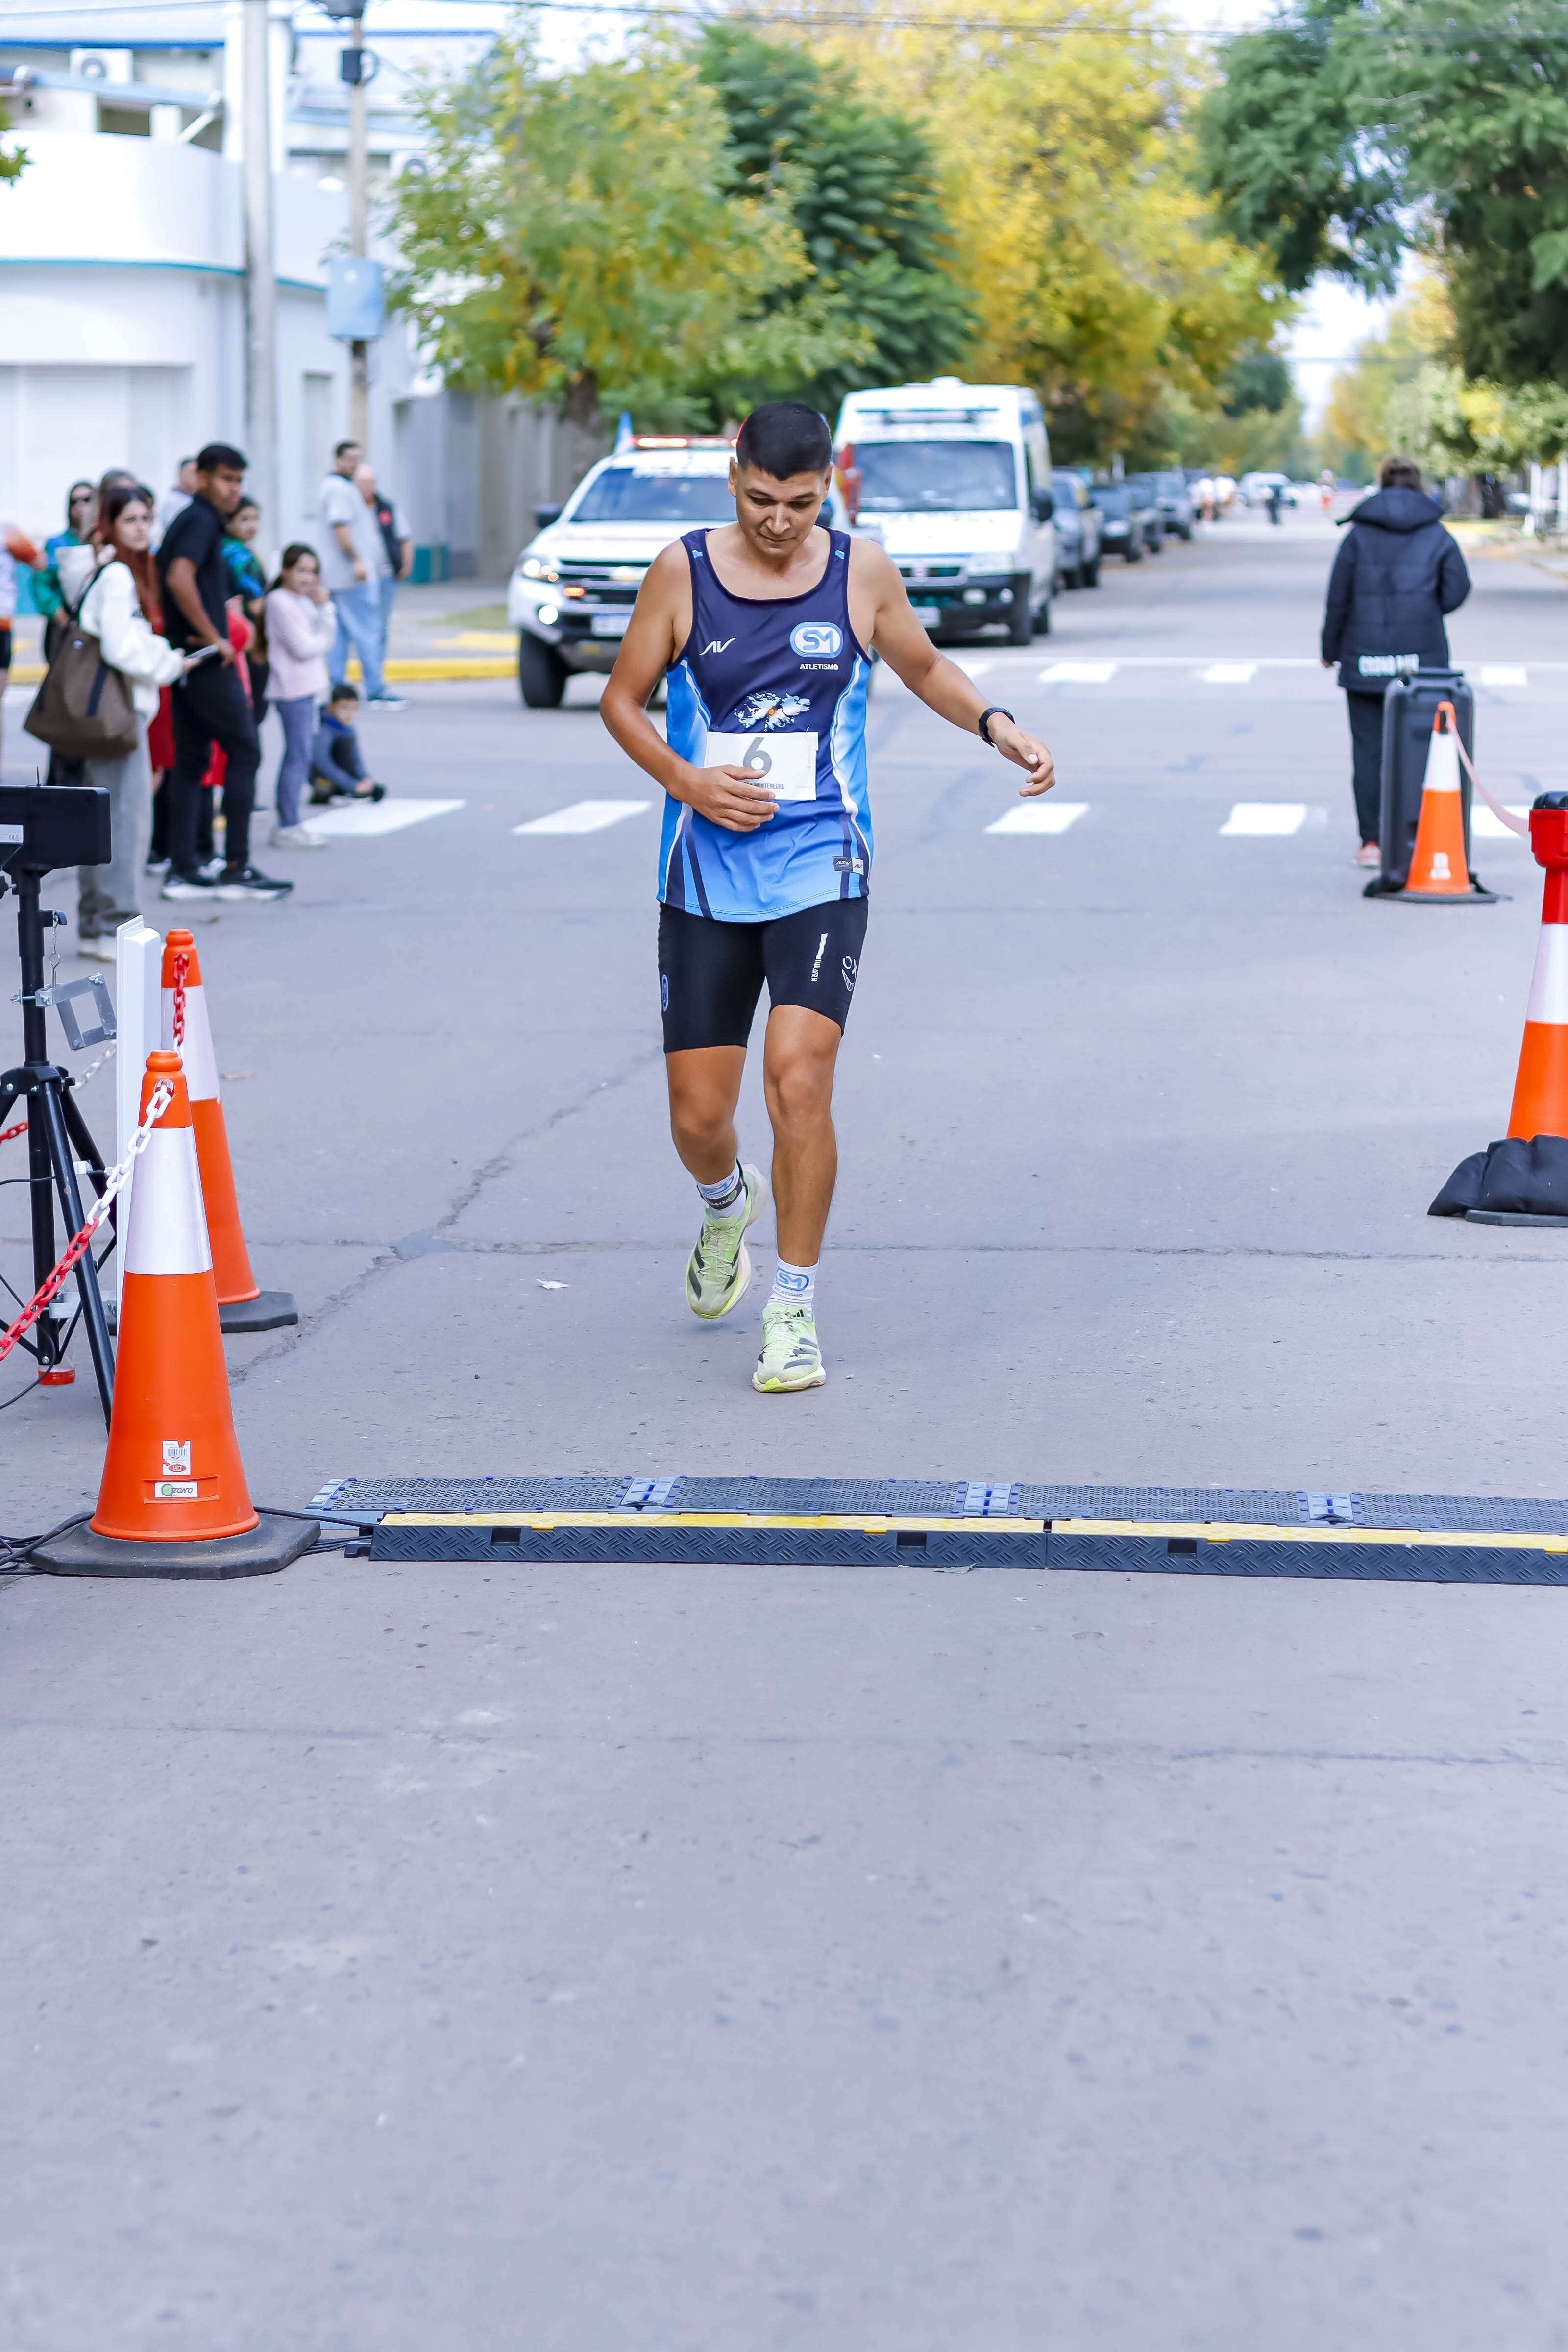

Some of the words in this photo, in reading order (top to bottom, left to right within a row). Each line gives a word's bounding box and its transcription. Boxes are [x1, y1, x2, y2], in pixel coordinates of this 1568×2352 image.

[802, 629, 834, 656] SM
[743, 737, 772, 779] 6
[774, 1286, 803, 1297] ATLETISMO
